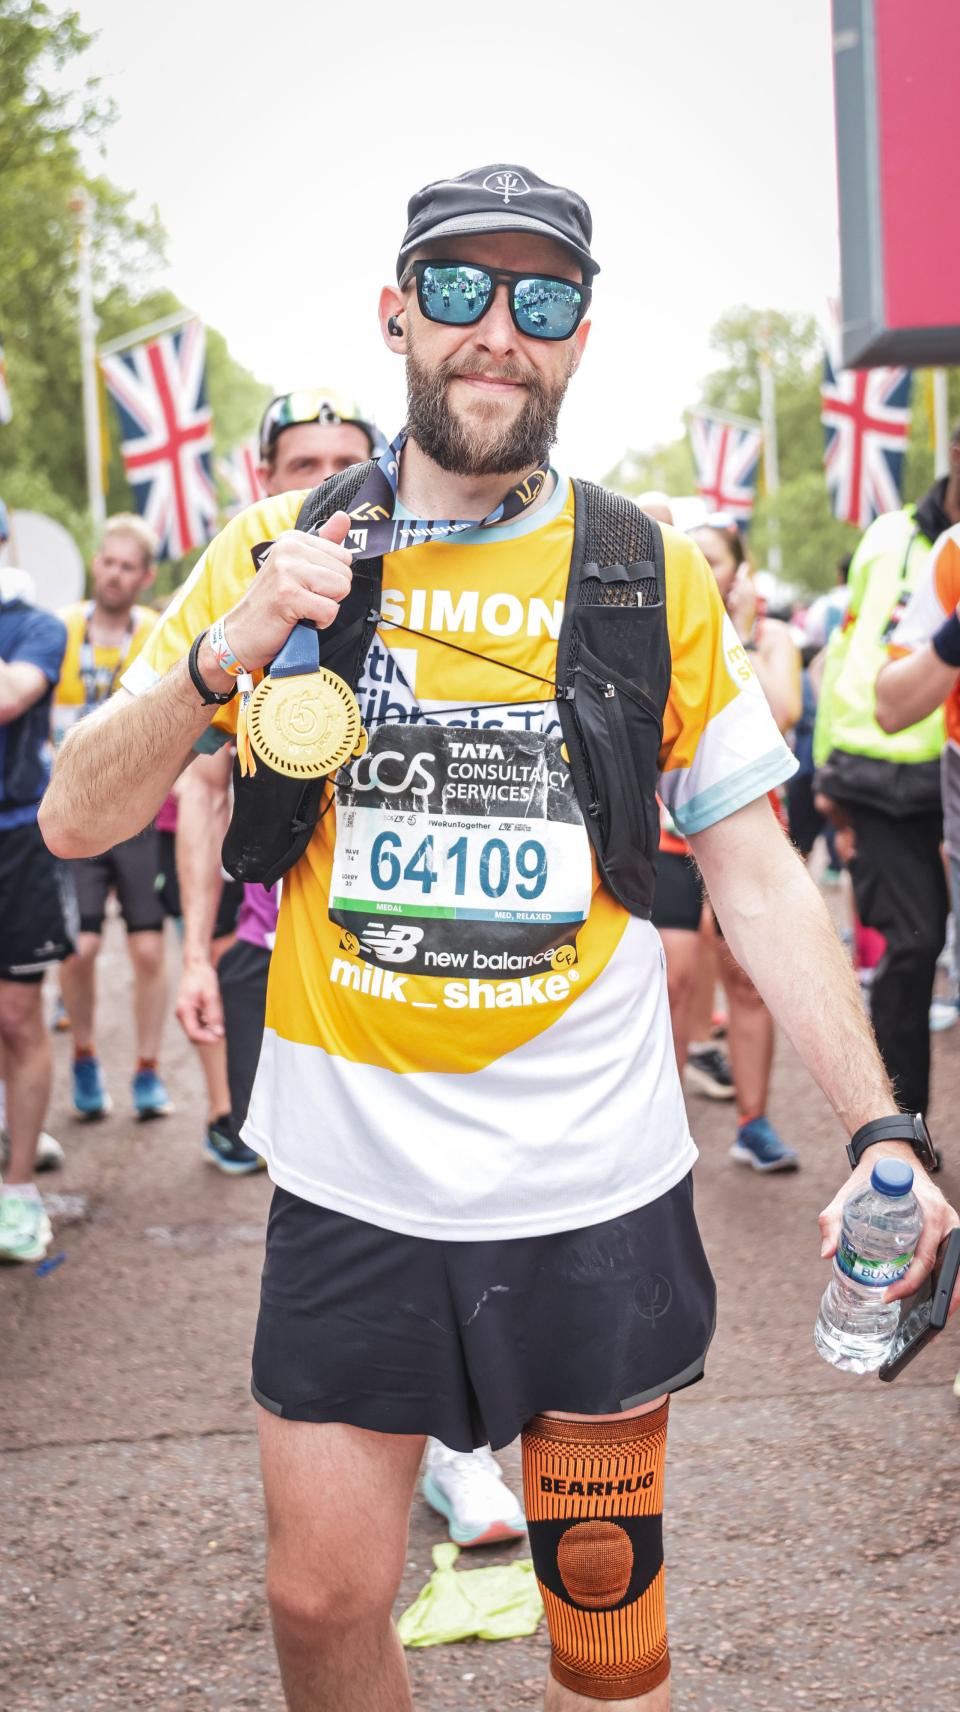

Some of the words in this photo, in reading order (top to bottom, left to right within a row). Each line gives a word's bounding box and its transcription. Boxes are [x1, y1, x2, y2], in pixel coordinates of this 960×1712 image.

[376, 589, 564, 640] SIMON
[448, 743, 505, 761] TATA
[446, 783, 531, 801] SERVICES
[370, 830, 548, 900] 64109
[376, 903, 403, 913] MEDAL
[494, 911, 513, 920] MED,
[516, 912, 552, 921] RELAXED
[424, 951, 469, 967] new
[473, 948, 555, 970] balance
[540, 1471, 655, 1496] BEARHUG
